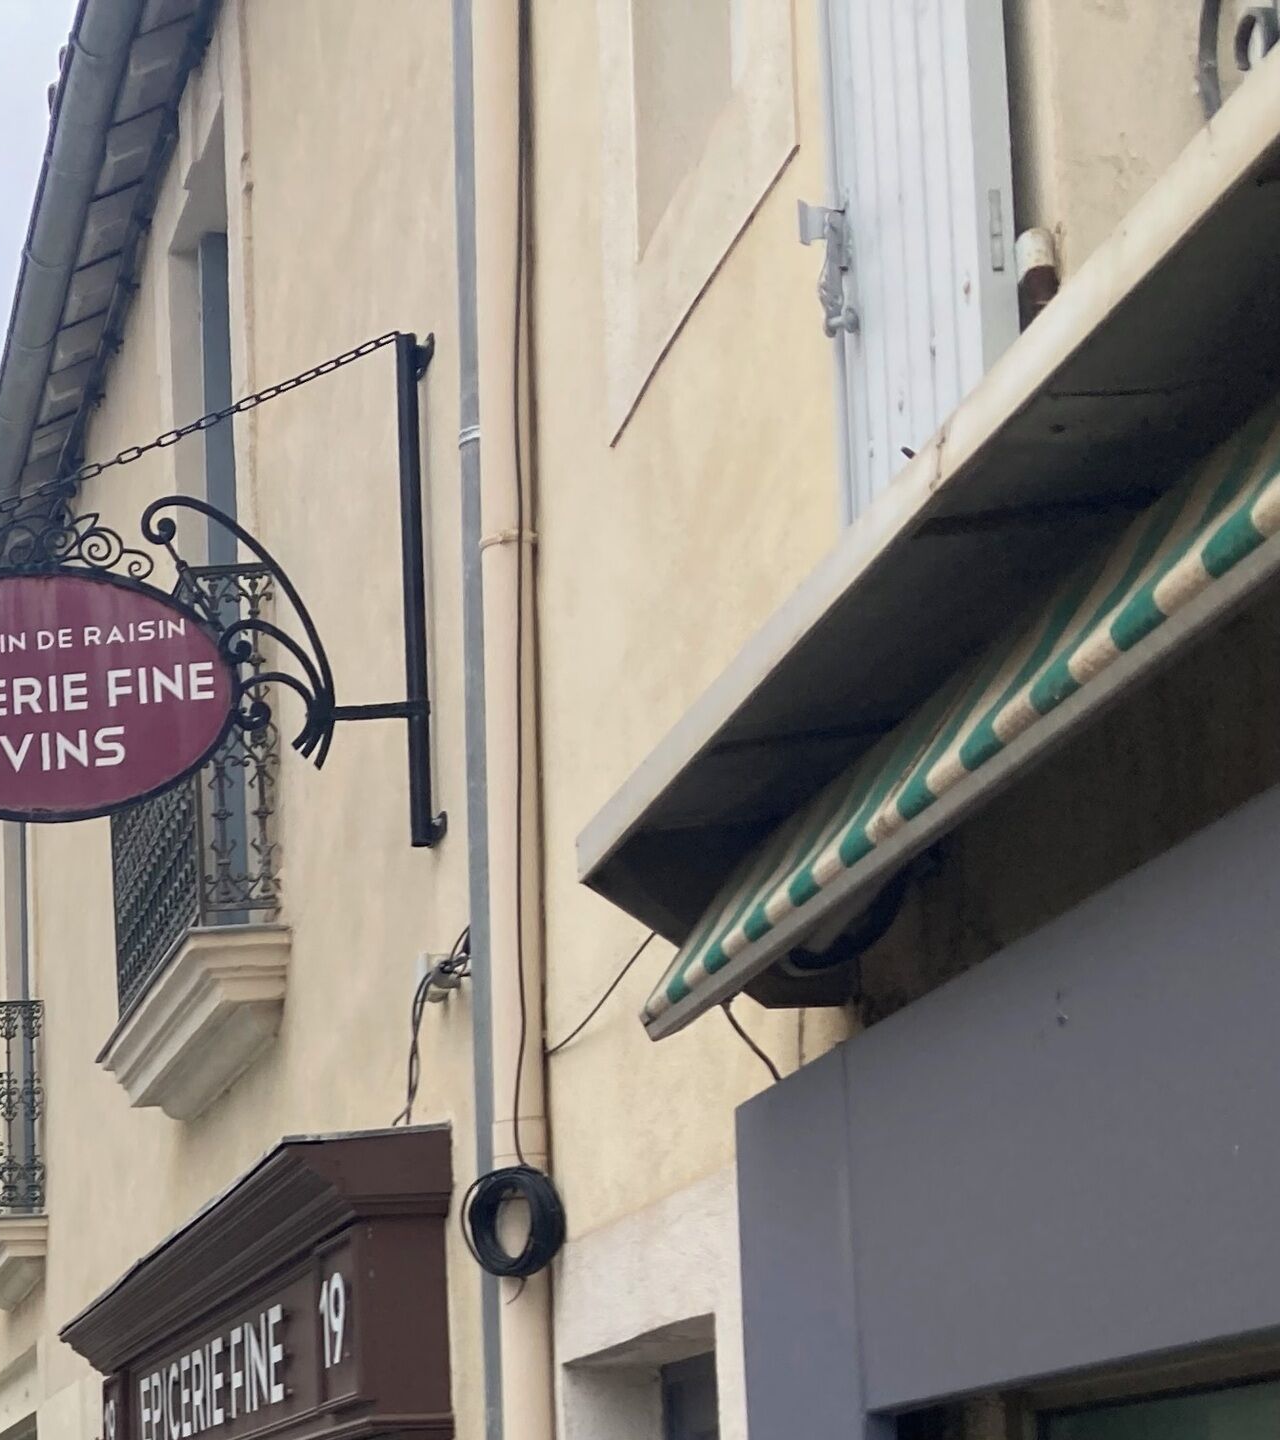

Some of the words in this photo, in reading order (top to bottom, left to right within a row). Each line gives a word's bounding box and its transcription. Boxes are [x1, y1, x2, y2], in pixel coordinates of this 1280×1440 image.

[37, 628, 73, 651] DE
[83, 618, 186, 647] RAISIN
[106, 661, 216, 708] FINE
[319, 1272, 345, 1368] 19
[230, 1304, 284, 1419] FINE
